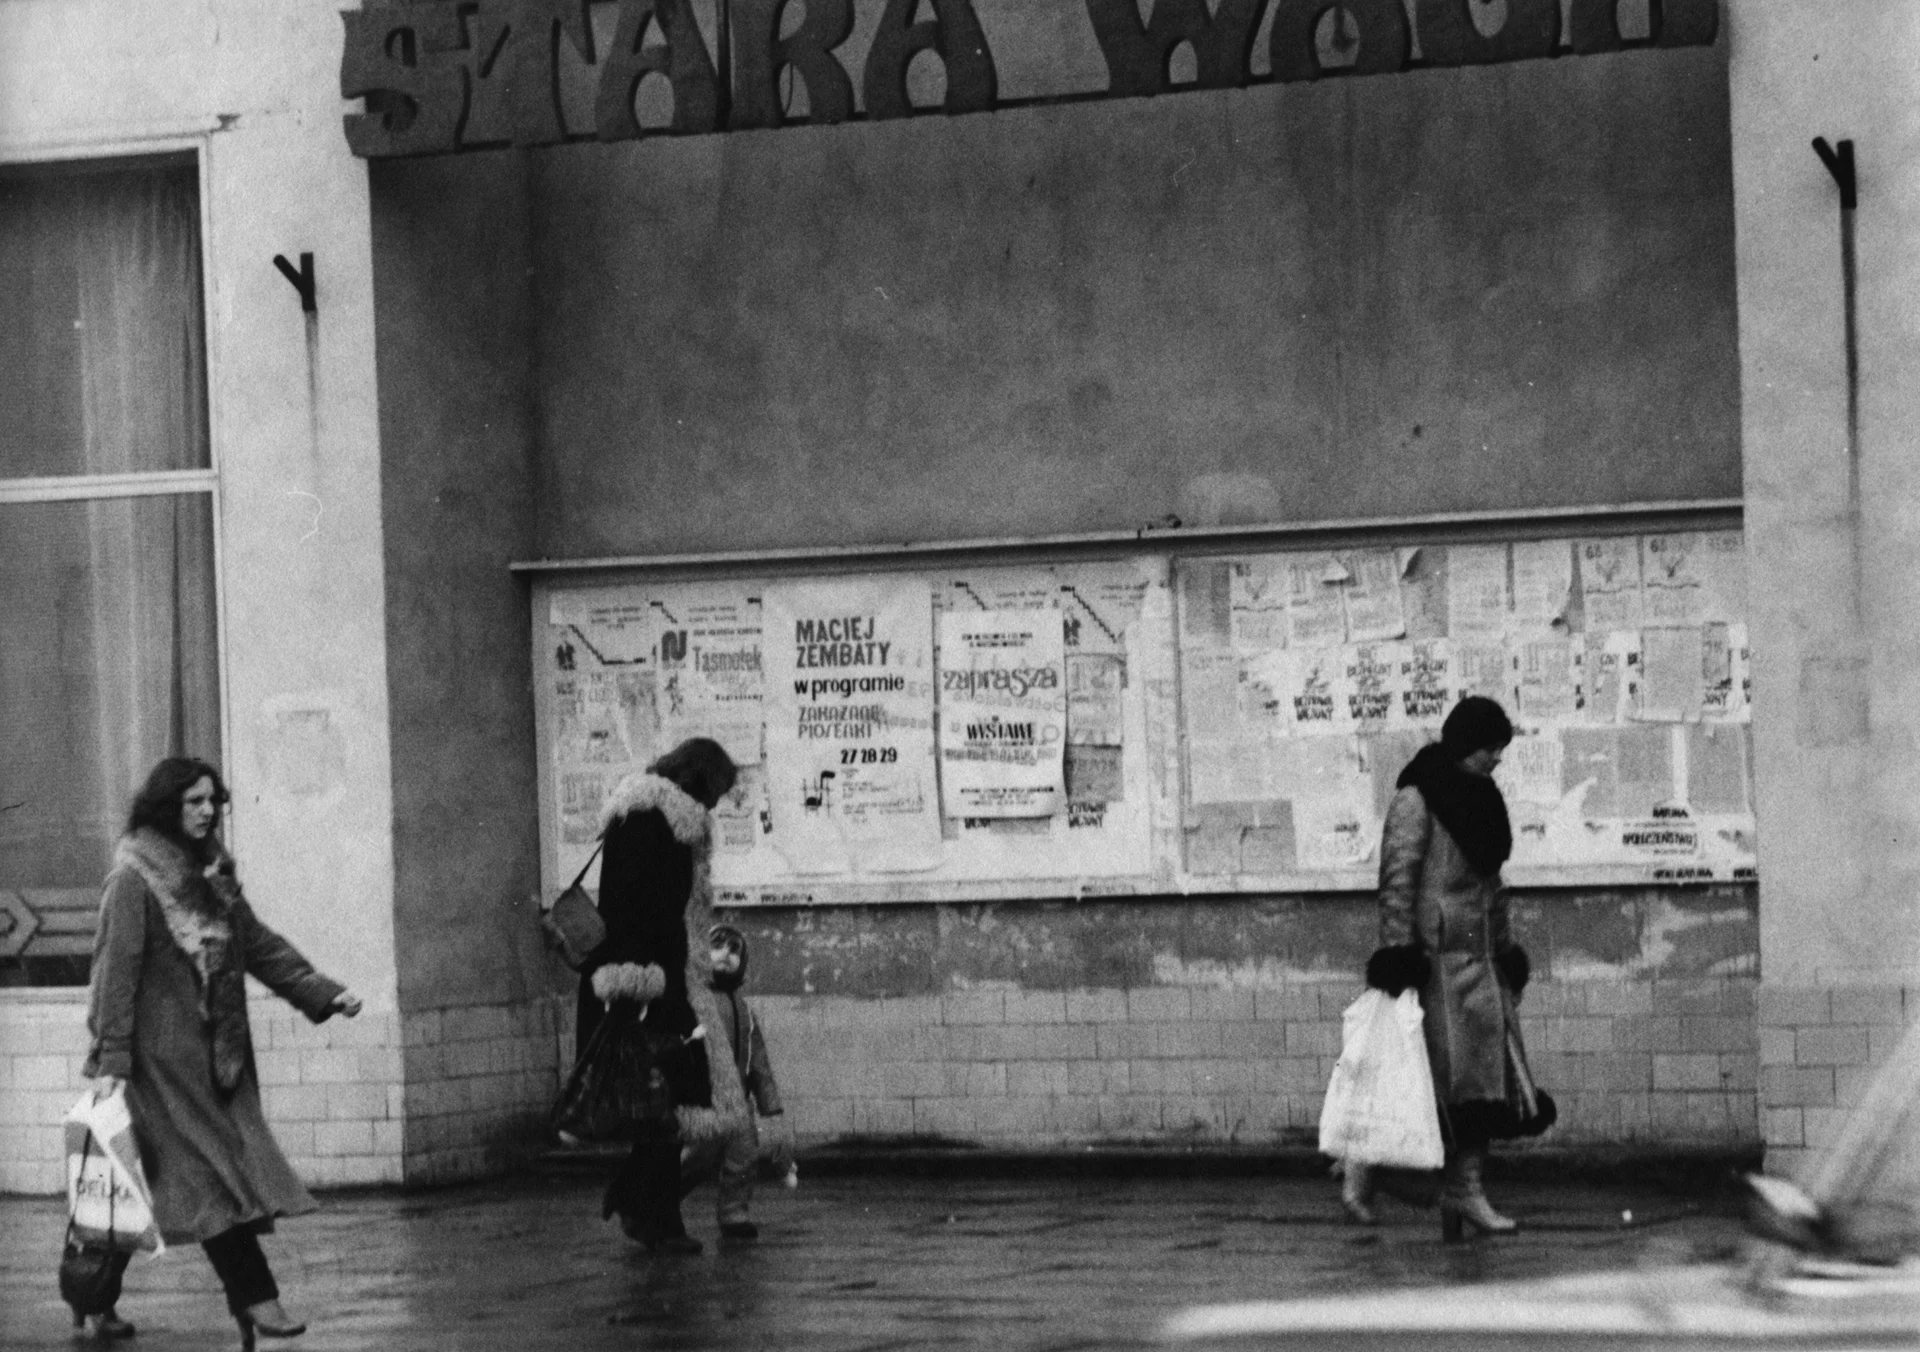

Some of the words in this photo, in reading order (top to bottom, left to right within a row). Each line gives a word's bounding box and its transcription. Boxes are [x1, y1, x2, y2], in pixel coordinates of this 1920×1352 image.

[341, 0, 998, 157] STARA
[795, 616, 876, 643] MACIEJ
[796, 641, 892, 669] ZEMBATY
[794, 679, 808, 695] w
[811, 672, 905, 702] programie
[840, 748, 858, 765] 27
[861, 747, 878, 764] 28
[880, 746, 898, 763] 29
